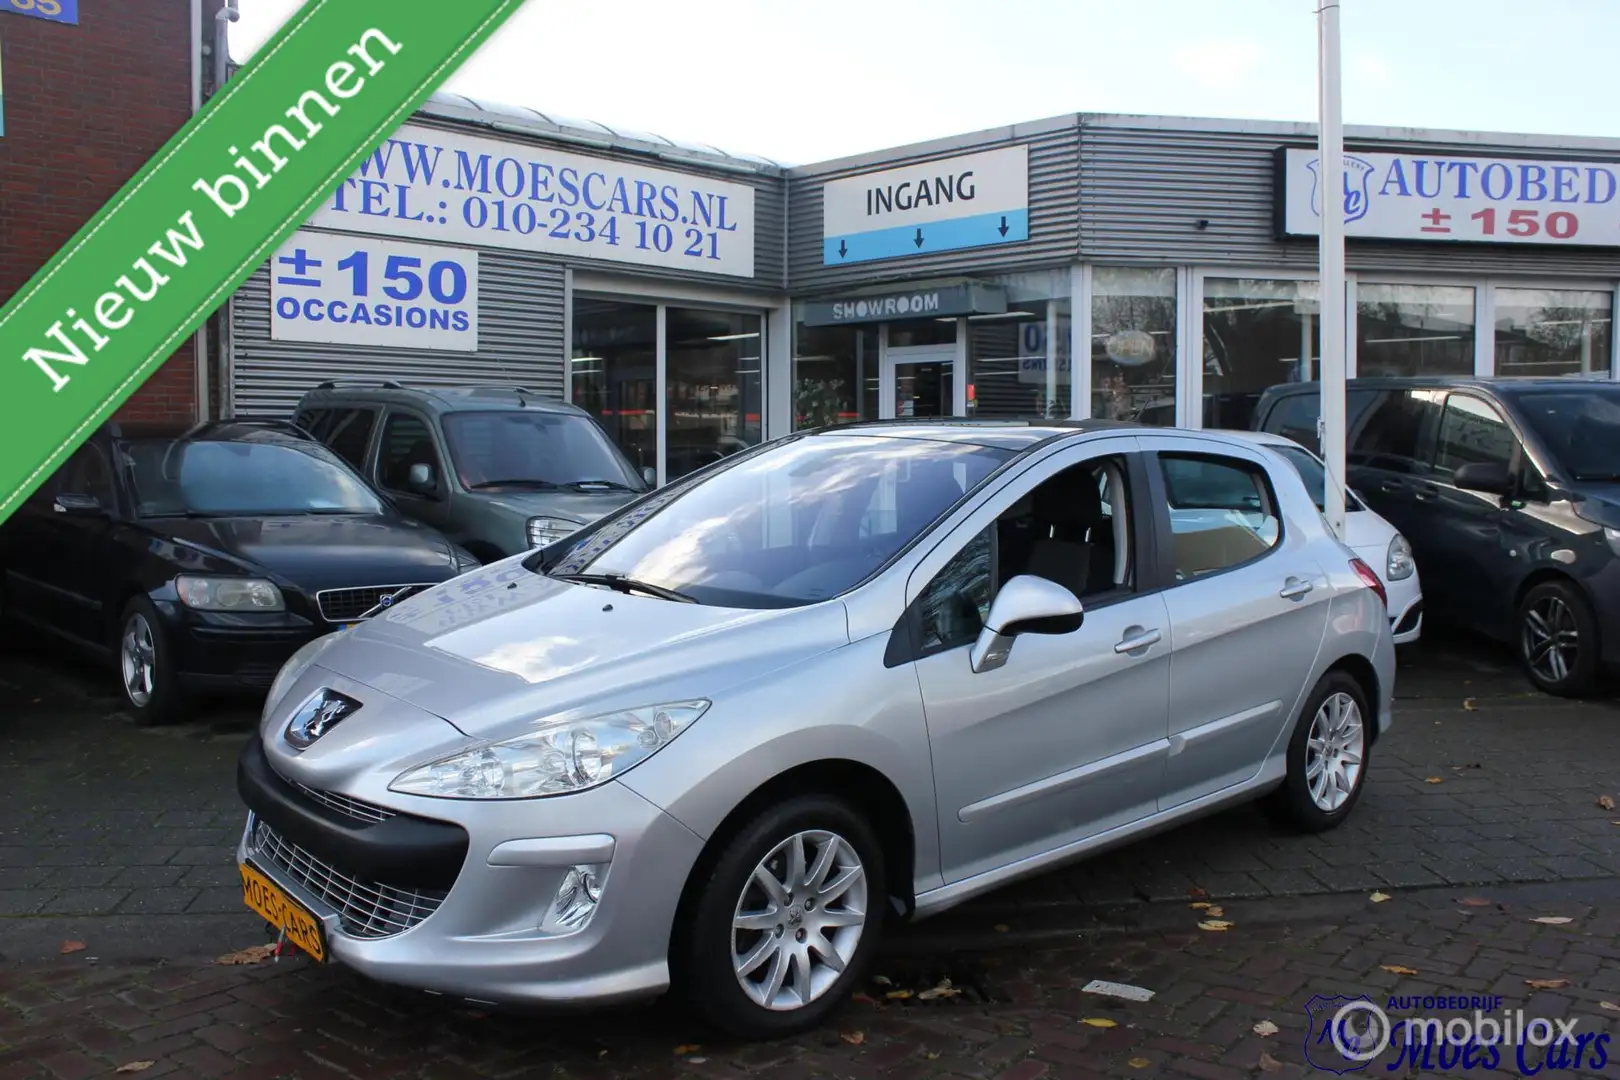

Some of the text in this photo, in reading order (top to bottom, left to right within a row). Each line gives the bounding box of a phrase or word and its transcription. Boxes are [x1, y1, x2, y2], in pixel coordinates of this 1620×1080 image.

[866, 171, 976, 216] INGANG
[1378, 158, 1618, 204] AUTOBED
[462, 196, 621, 247] 010-234
[635, 221, 673, 252] 10
[683, 228, 721, 260] 21
[1471, 208, 1579, 239] 150
[276, 297, 470, 332] OCCASIONS
[832, 293, 939, 320] SHOWROOM
[243, 875, 321, 954] MOES-CARS
